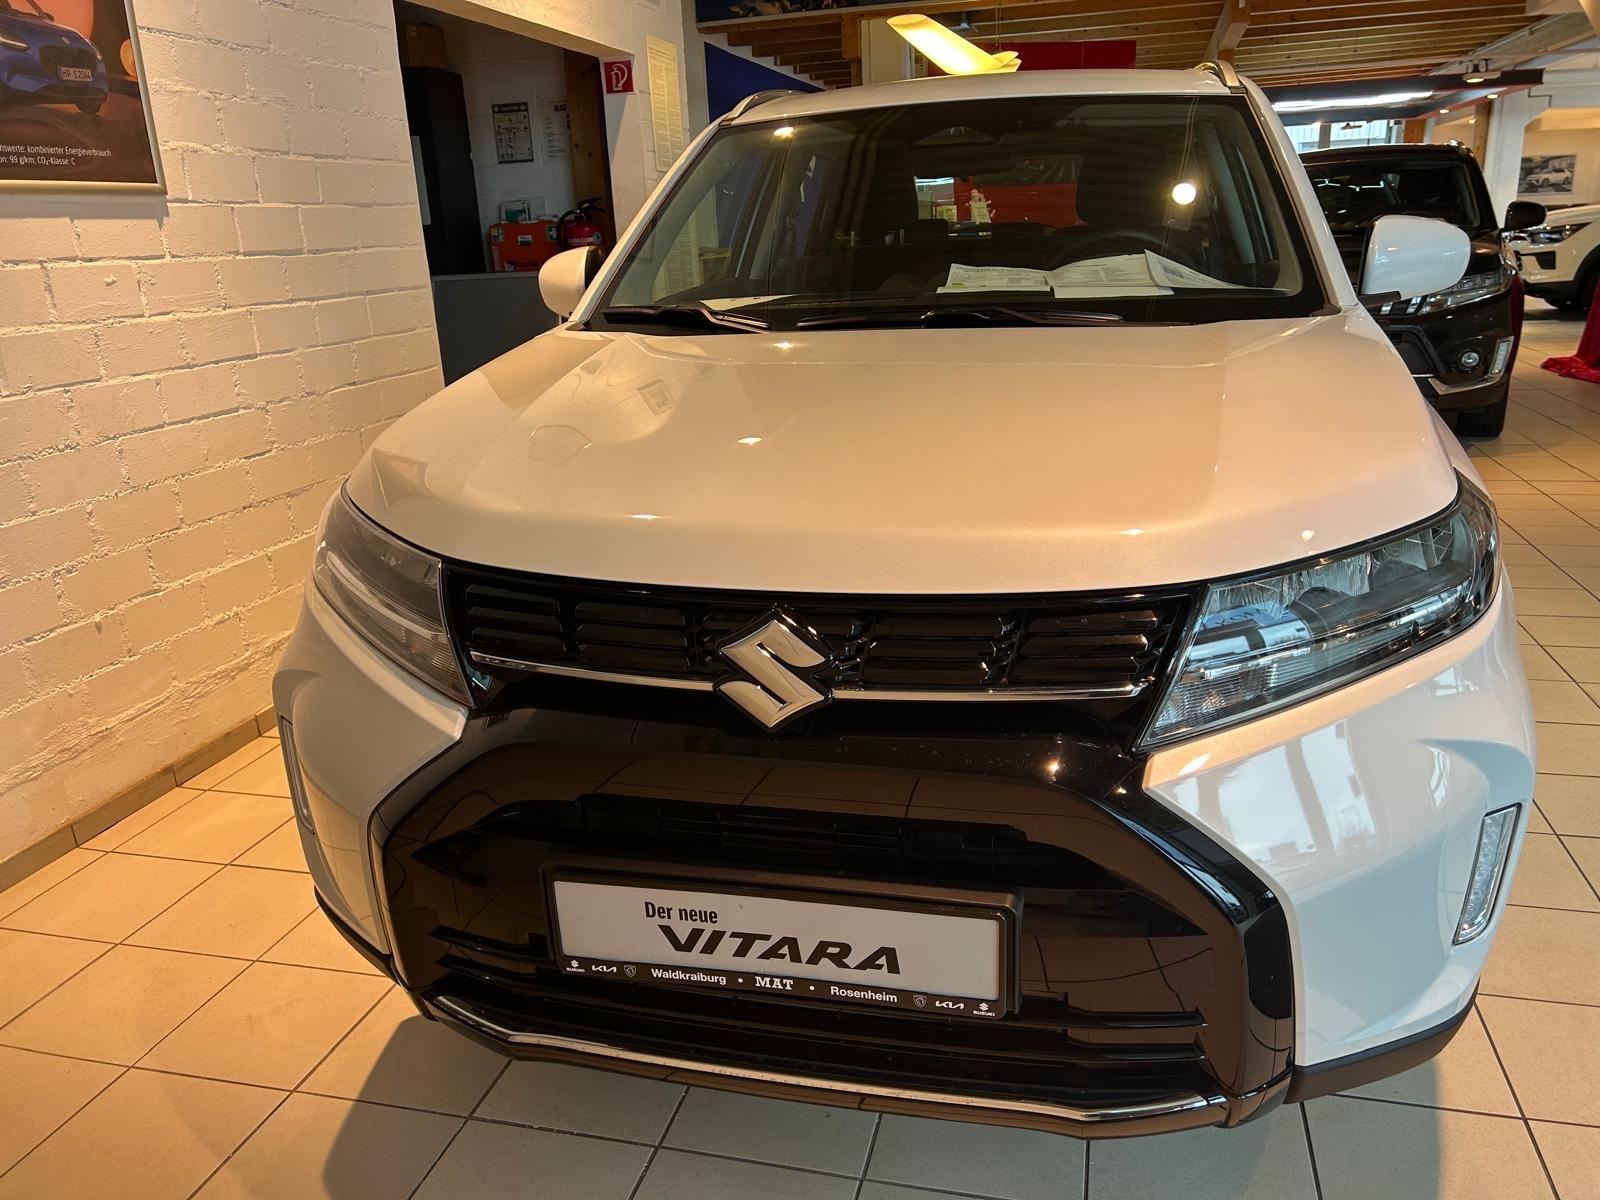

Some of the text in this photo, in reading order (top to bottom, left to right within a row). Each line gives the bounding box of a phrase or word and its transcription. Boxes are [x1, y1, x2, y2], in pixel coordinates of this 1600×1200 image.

[9, 155, 18, 164] 99
[27, 144, 64, 155] kombinierter
[65, 146, 112, 157] Energieverbrauch
[644, 901, 718, 924] Der neue
[657, 924, 901, 975] VITARA
[651, 967, 898, 1003] Waldkraiburg MAT Rosenheim
